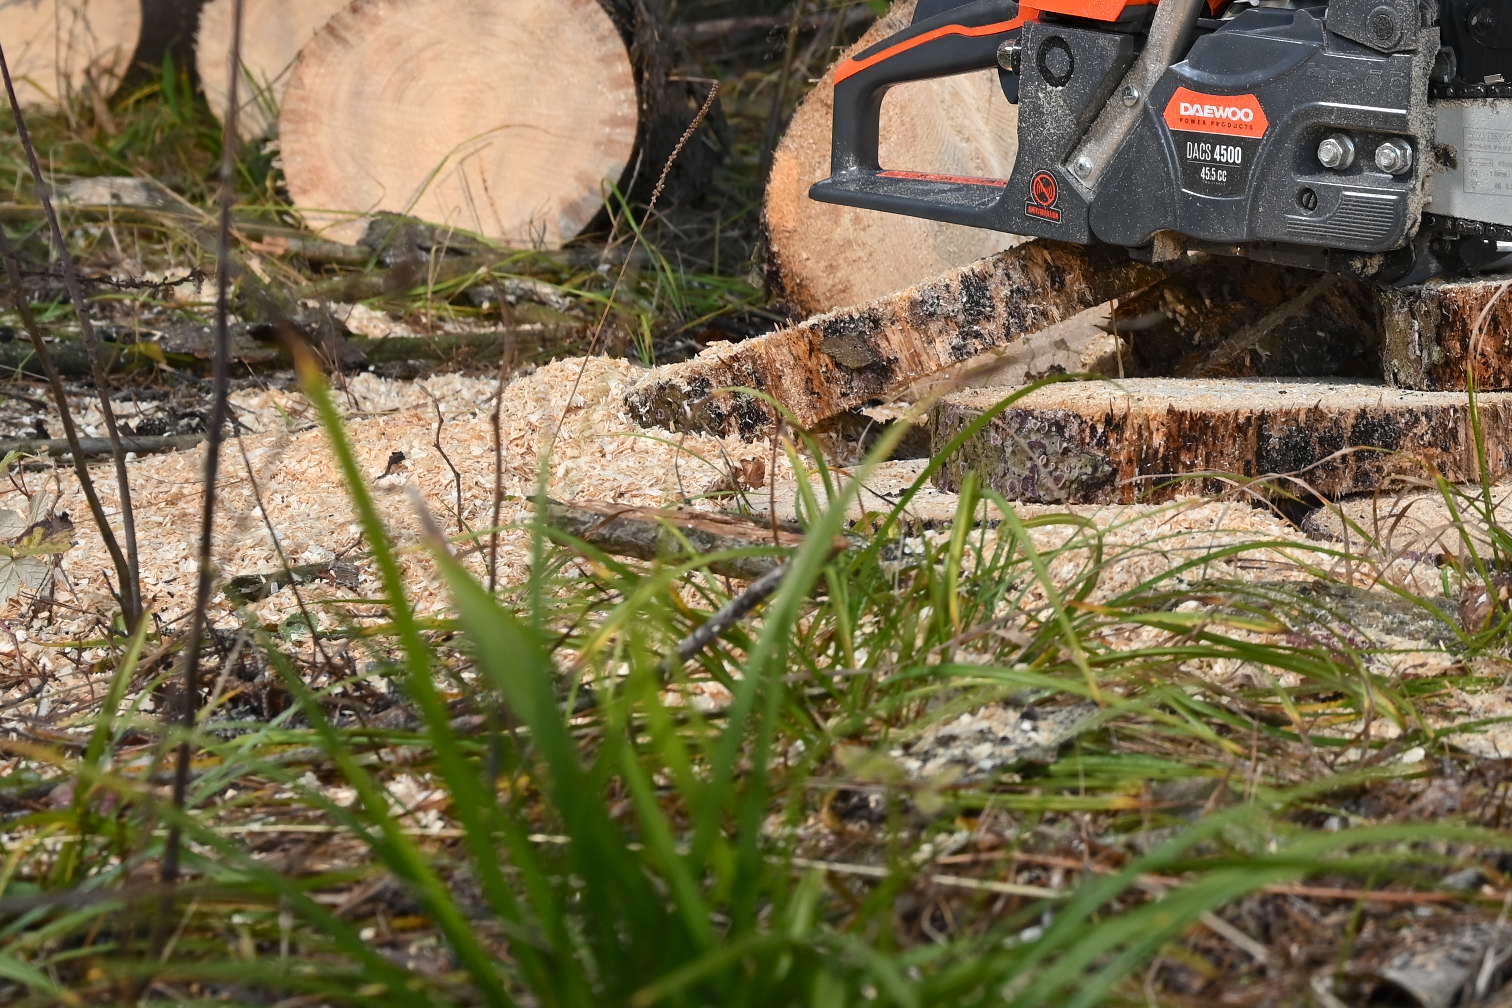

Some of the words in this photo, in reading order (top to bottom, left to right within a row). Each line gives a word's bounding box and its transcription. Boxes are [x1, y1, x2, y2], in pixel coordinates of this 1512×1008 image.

[1180, 102, 1254, 122] DAEWOO
[1179, 117, 1206, 125] POWER
[1210, 120, 1253, 130] PRODUCTS
[1186, 141, 1212, 161] DACS
[1213, 144, 1242, 164] 4500
[1200, 166, 1216, 181] 45.5
